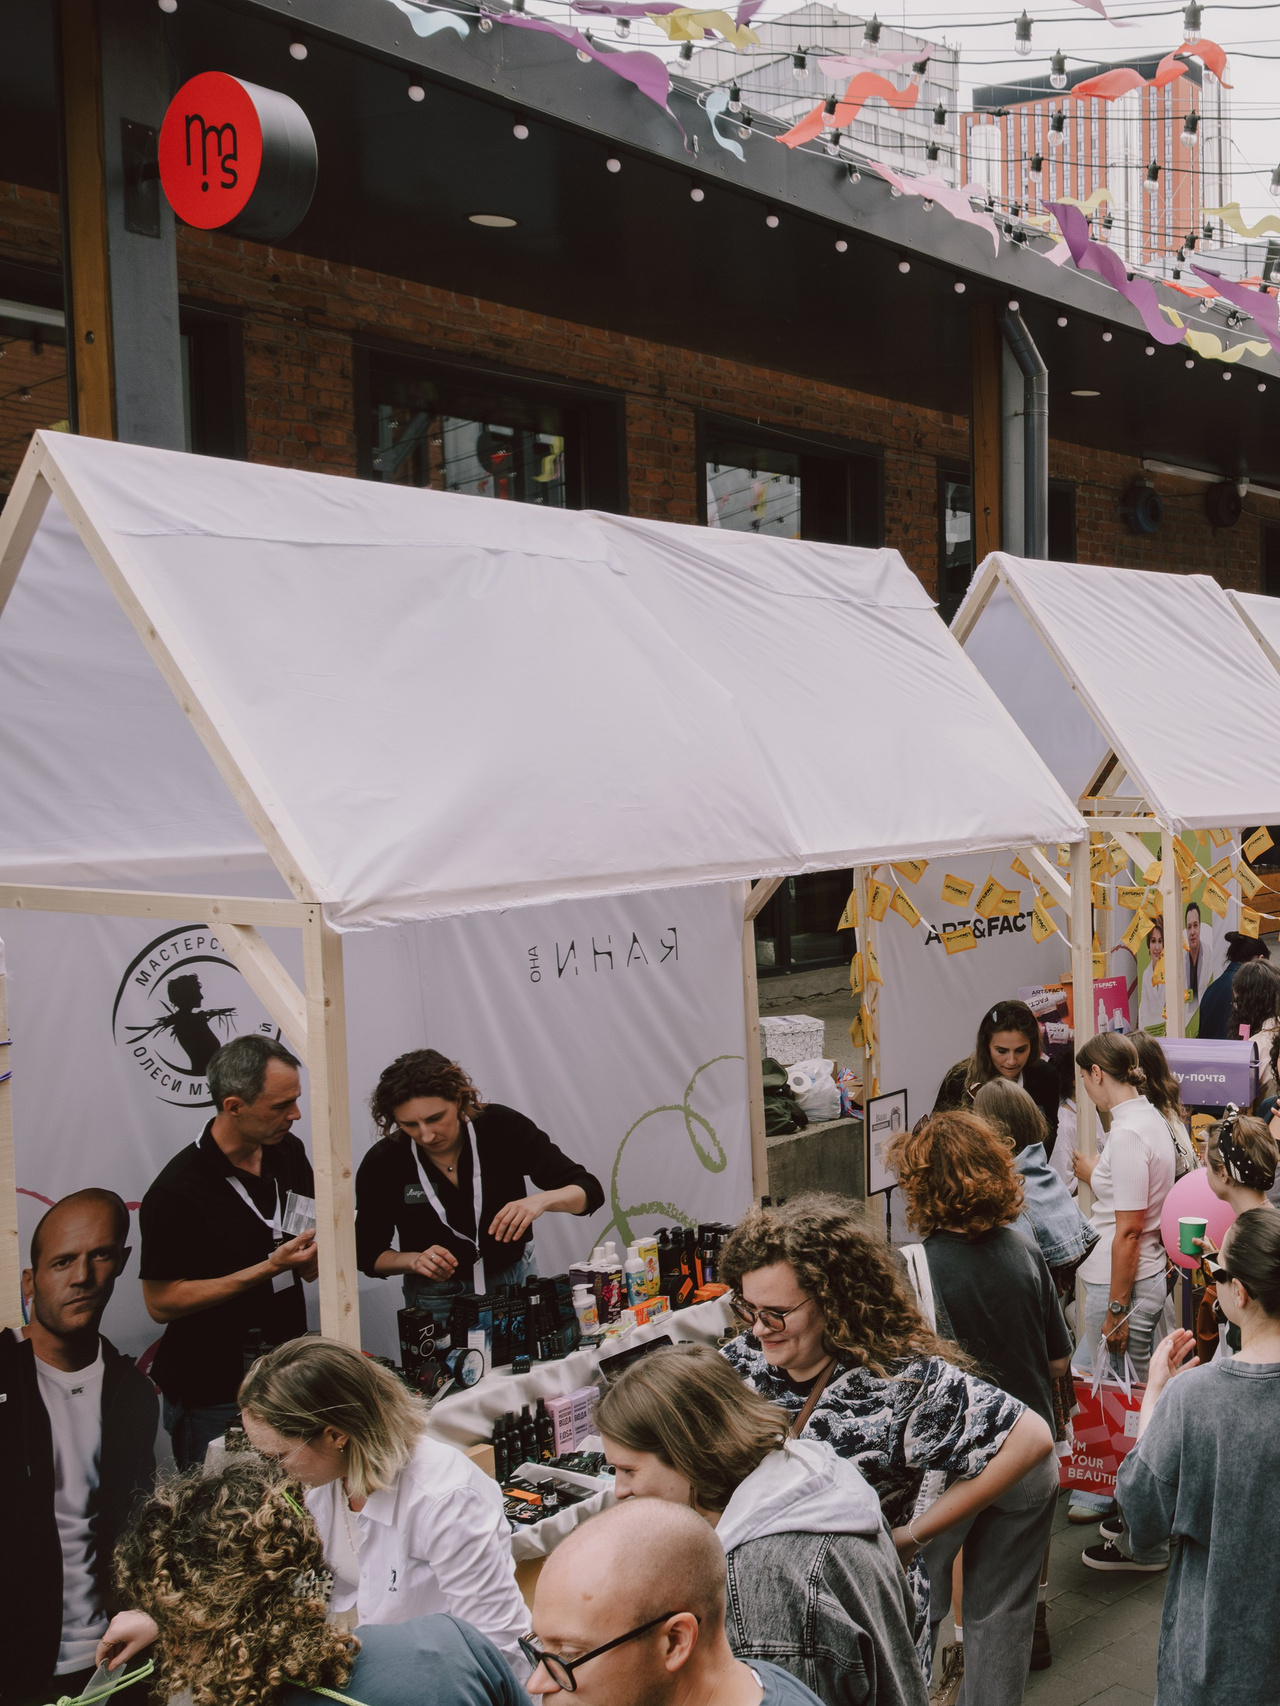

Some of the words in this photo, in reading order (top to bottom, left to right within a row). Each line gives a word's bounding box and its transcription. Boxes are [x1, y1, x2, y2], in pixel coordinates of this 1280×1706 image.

[134, 936, 225, 987] МАСТЕРС
[528, 946, 541, 982] ОНА
[556, 927, 678, 978] ИНАЯ
[1032, 988, 1065, 996] ART&FACT.
[133, 1046, 182, 1092] ОЛЕСИ
[1070, 1454, 1104, 1469] YOUR
